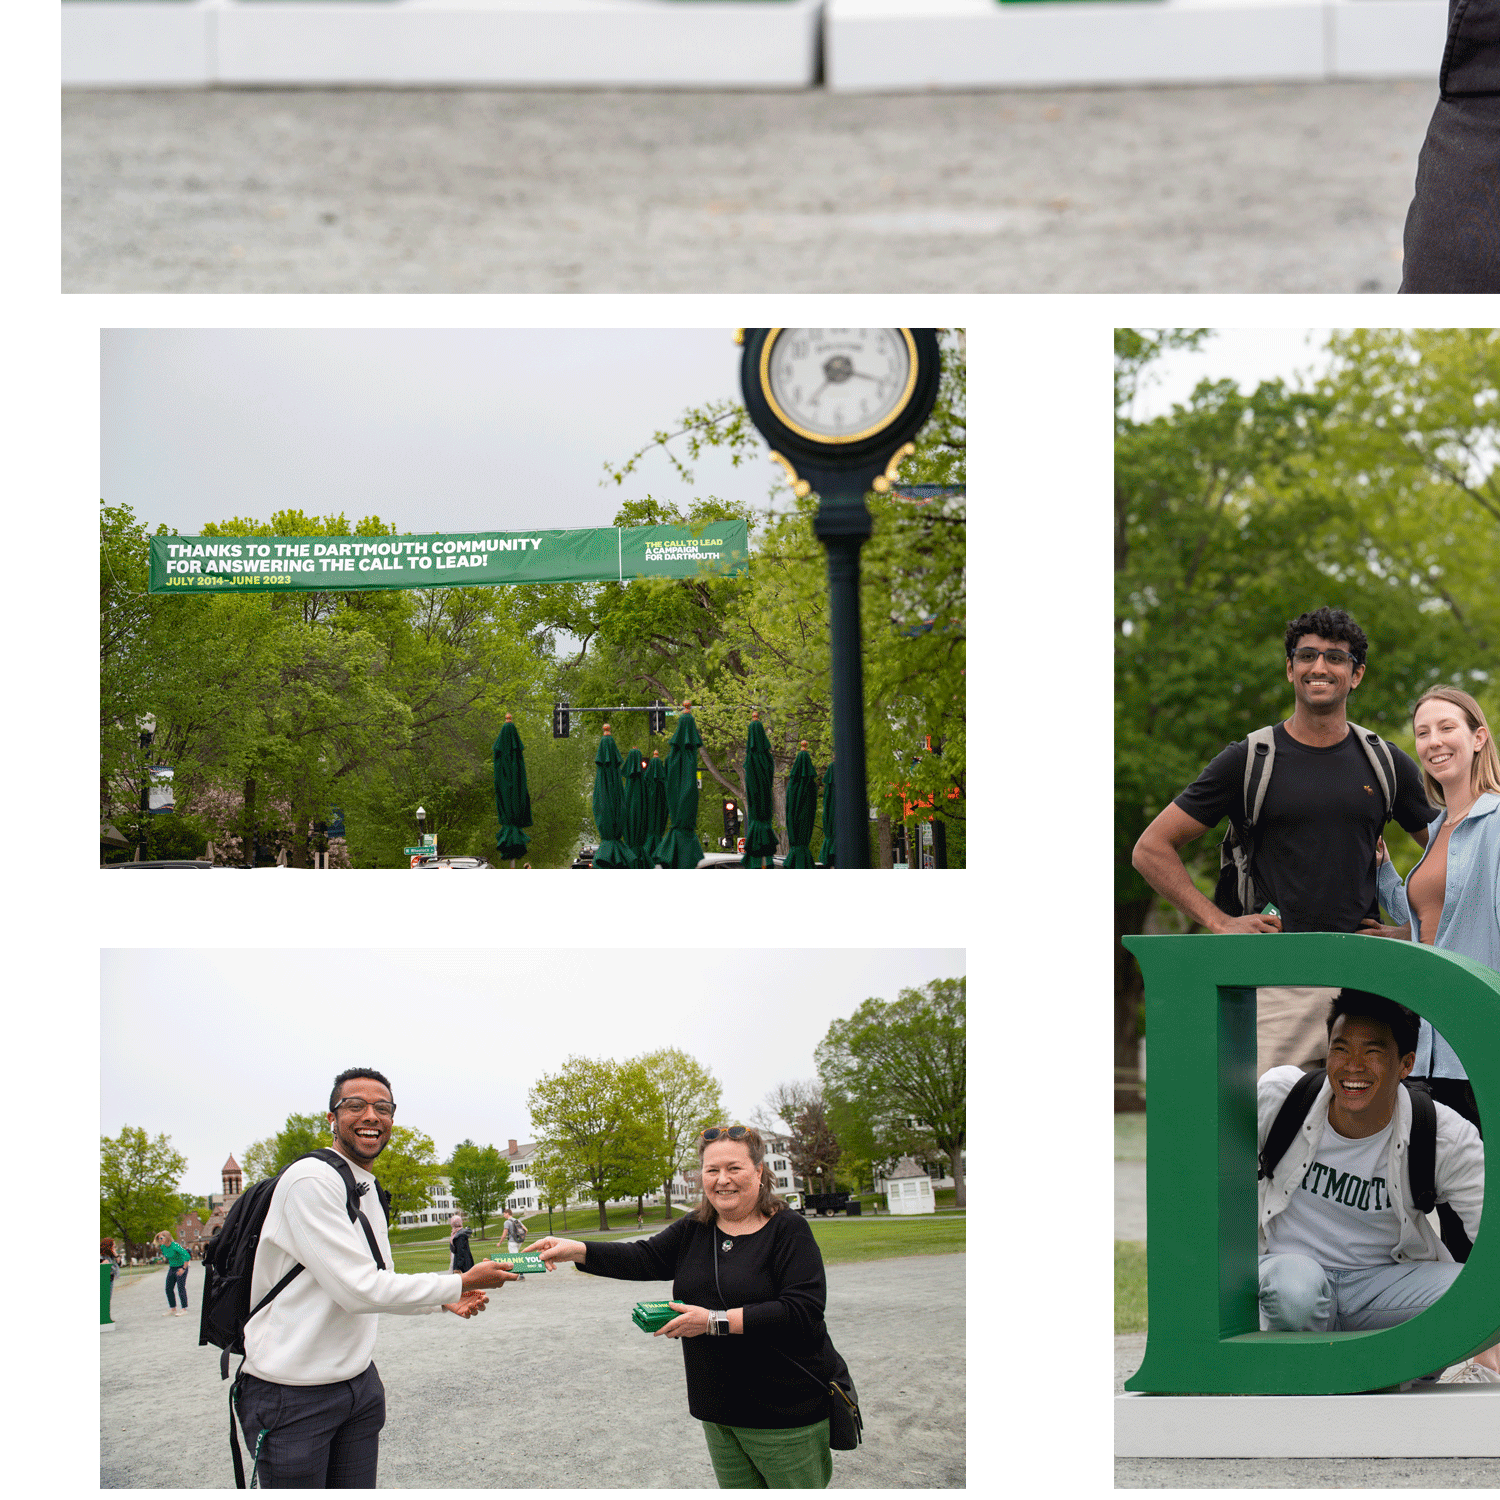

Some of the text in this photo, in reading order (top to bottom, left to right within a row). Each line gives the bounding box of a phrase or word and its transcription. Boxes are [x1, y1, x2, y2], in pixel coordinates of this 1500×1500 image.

[700, 538, 723, 546] LEAD
[168, 537, 543, 557] THANKS TO THE DARTMOUTH COMMUNITY
[653, 546, 699, 554] CAMPAIGN
[664, 552, 720, 560] DARTMOUTH
[166, 554, 488, 574] FOR ANSWERING THE CALL TO LEAD!
[166, 576, 194, 586] JULY
[263, 575, 291, 585] 2023
